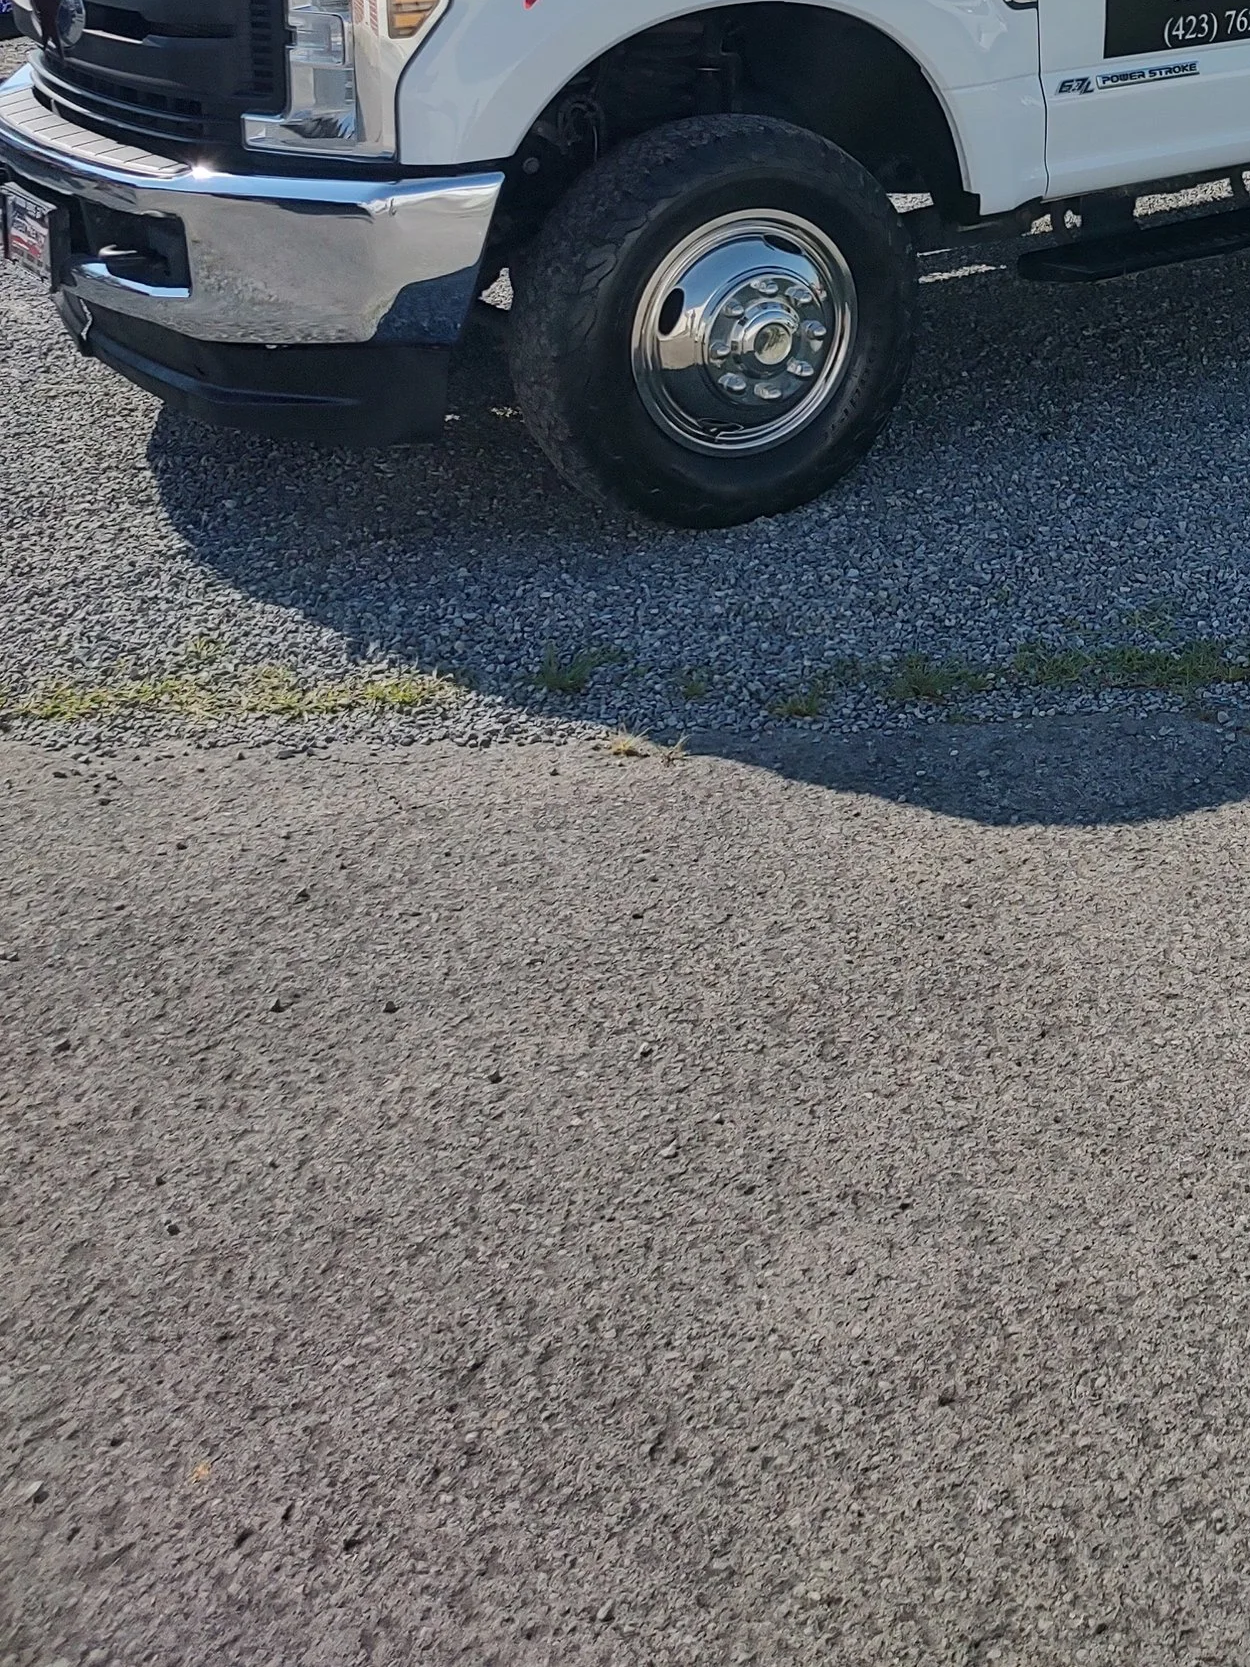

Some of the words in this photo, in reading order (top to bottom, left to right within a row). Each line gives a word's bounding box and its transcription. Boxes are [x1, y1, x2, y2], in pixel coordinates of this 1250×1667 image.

[1163, 11, 1219, 48] (423)
[1102, 71, 1147, 85] POWER
[1149, 62, 1198, 78] STROKE
